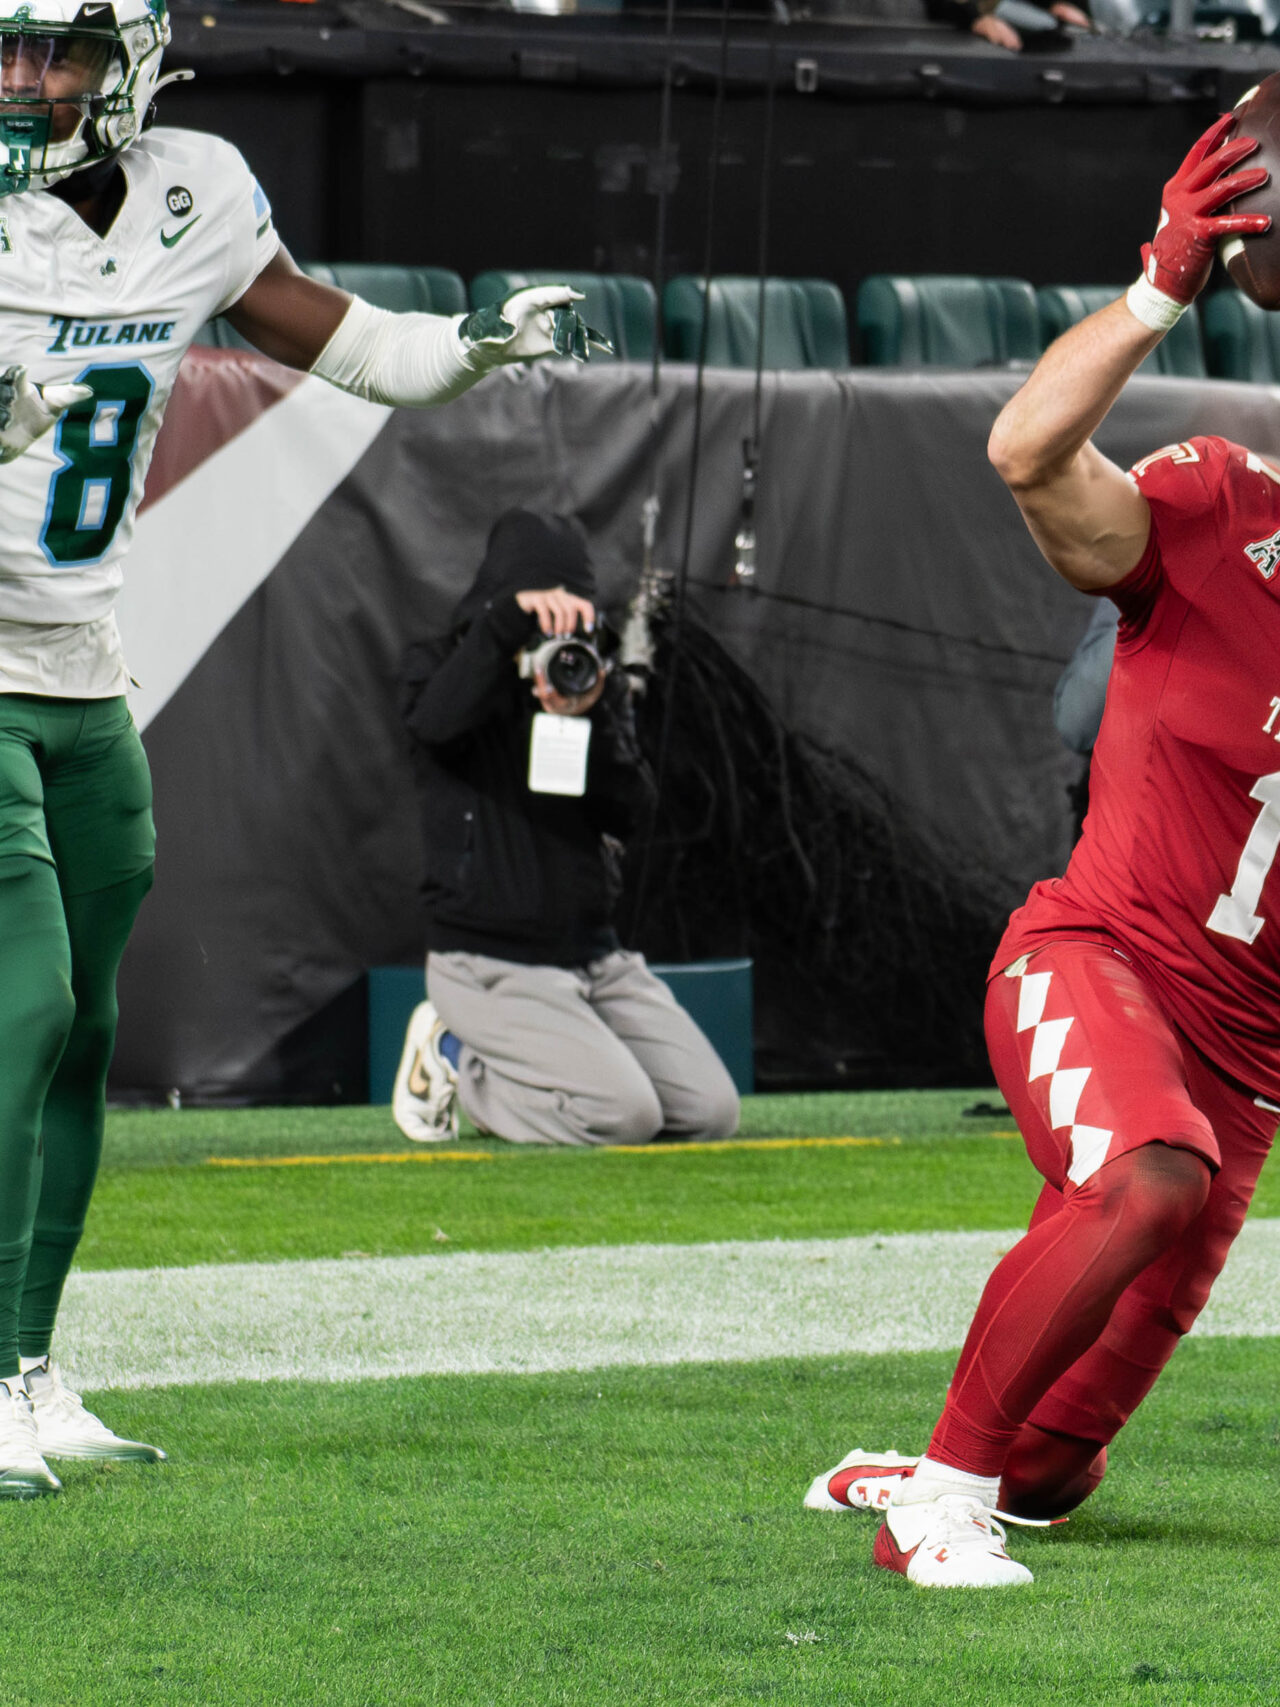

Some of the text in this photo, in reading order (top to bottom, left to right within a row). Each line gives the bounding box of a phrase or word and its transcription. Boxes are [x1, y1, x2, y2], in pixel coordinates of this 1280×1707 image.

[168, 192, 192, 212] GG
[46, 313, 177, 354] TULANE
[37, 359, 156, 568] 8
